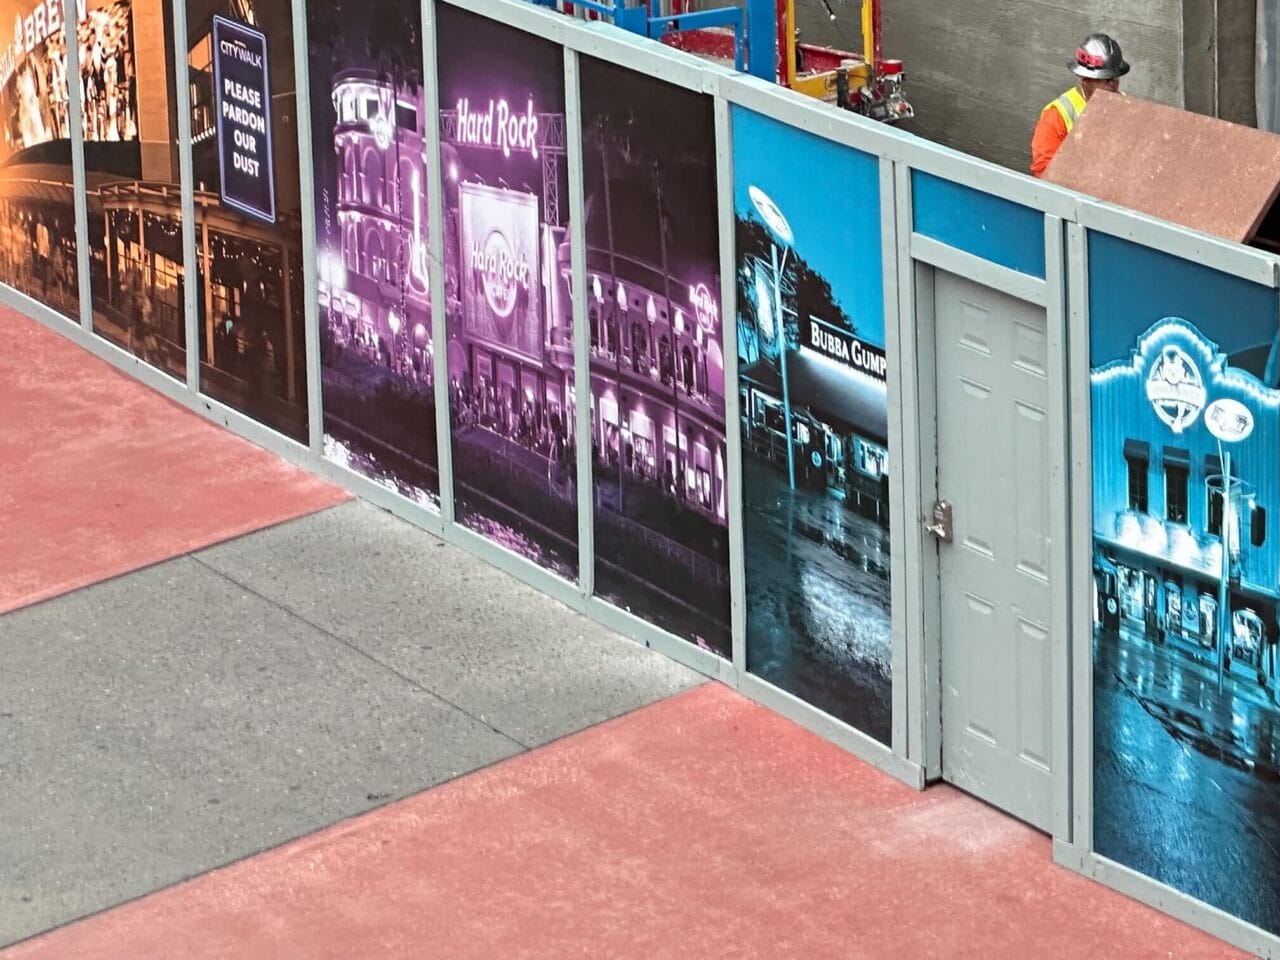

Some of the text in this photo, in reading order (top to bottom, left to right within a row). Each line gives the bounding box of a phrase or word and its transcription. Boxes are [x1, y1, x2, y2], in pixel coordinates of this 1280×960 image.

[220, 40, 262, 68] CITYWALK
[224, 78, 261, 108] PLEASE
[222, 101, 265, 134] PARDON
[457, 98, 494, 145] Hard
[497, 99, 538, 159] Rock
[233, 129, 256, 152] OUR
[233, 151, 259, 177] DUST
[811, 321, 886, 376] BUBBA GUMP
